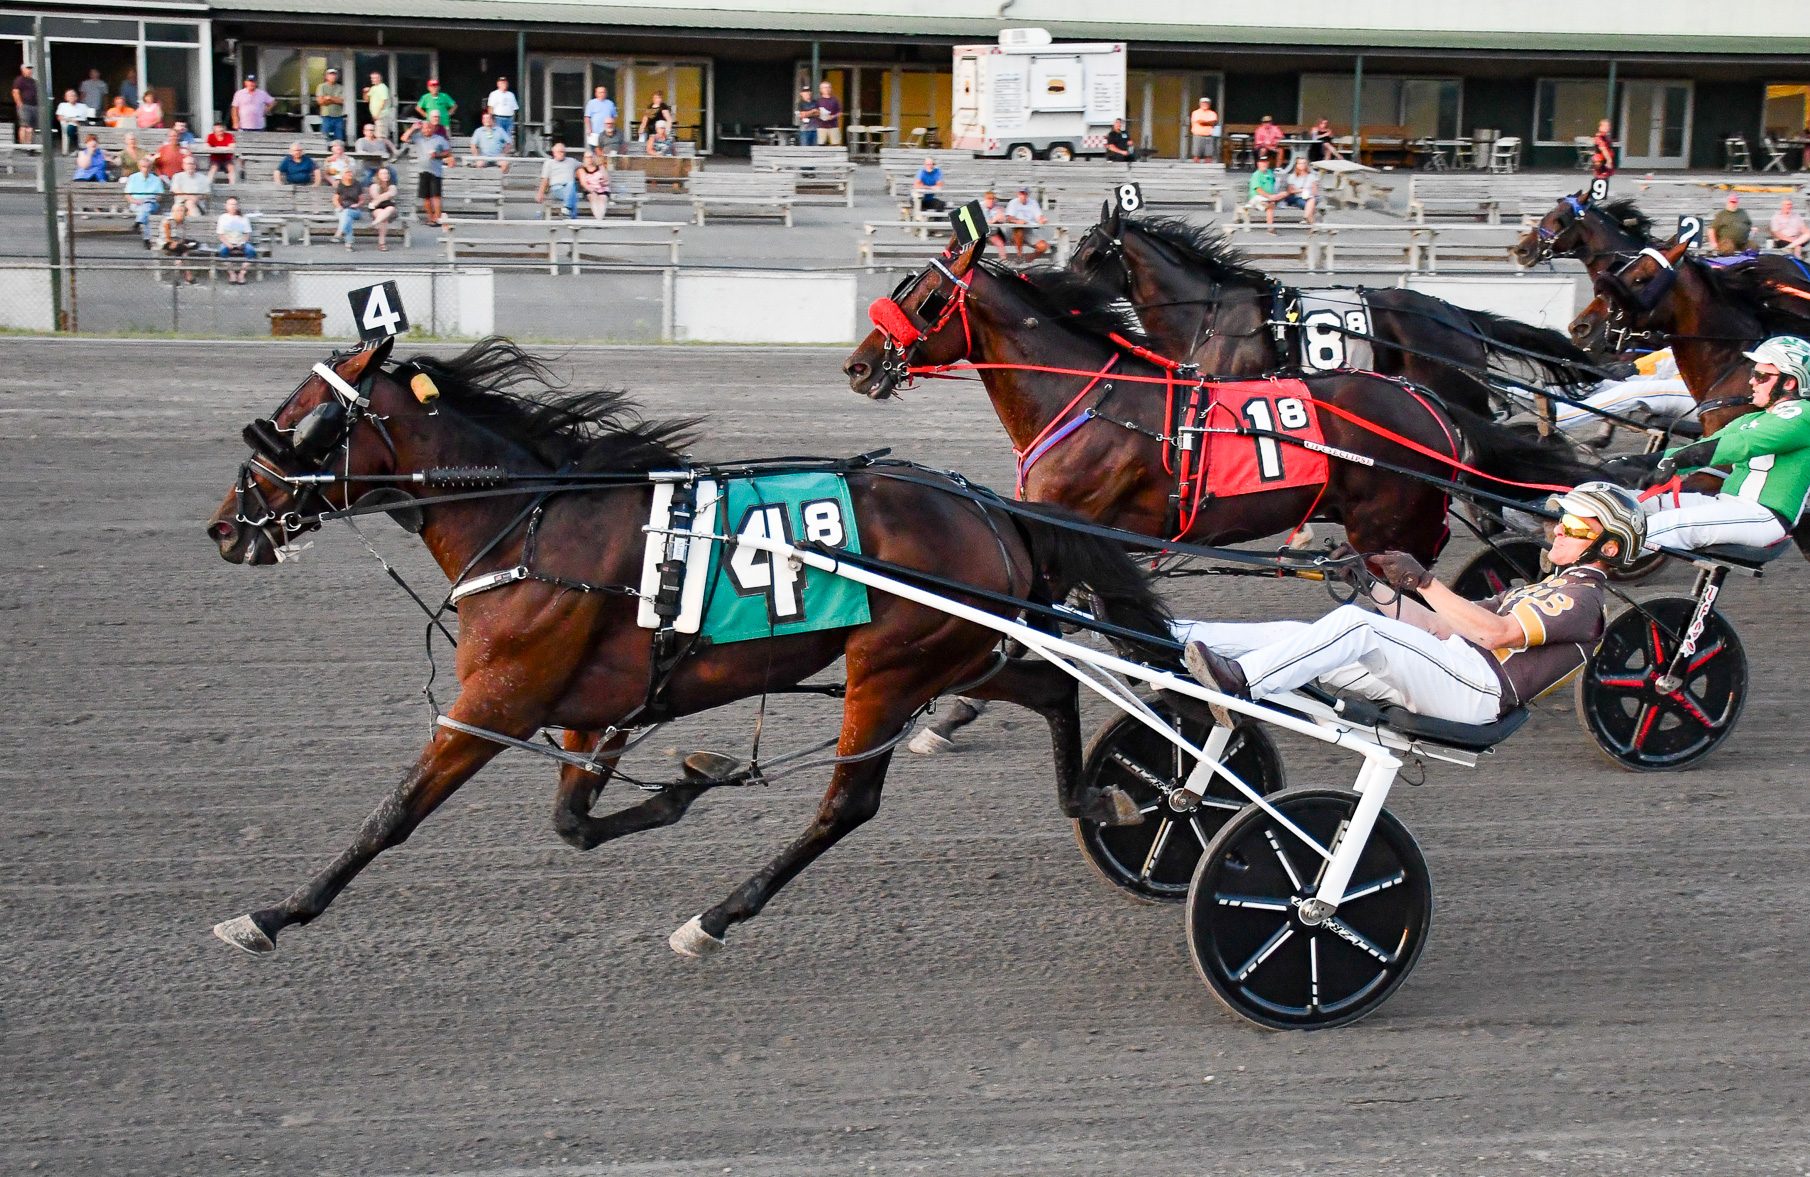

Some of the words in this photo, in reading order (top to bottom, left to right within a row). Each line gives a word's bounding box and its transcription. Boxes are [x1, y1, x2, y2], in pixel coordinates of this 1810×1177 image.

[1119, 184, 1139, 212] 8
[1593, 179, 1607, 200] 9
[958, 205, 981, 242] 1
[1679, 217, 1700, 248] 2
[363, 284, 401, 336] 4
[1346, 311, 1368, 335] 8
[1245, 399, 1282, 480] 1
[1275, 397, 1309, 430] 8
[727, 504, 804, 622] 4
[803, 499, 847, 548] 8
